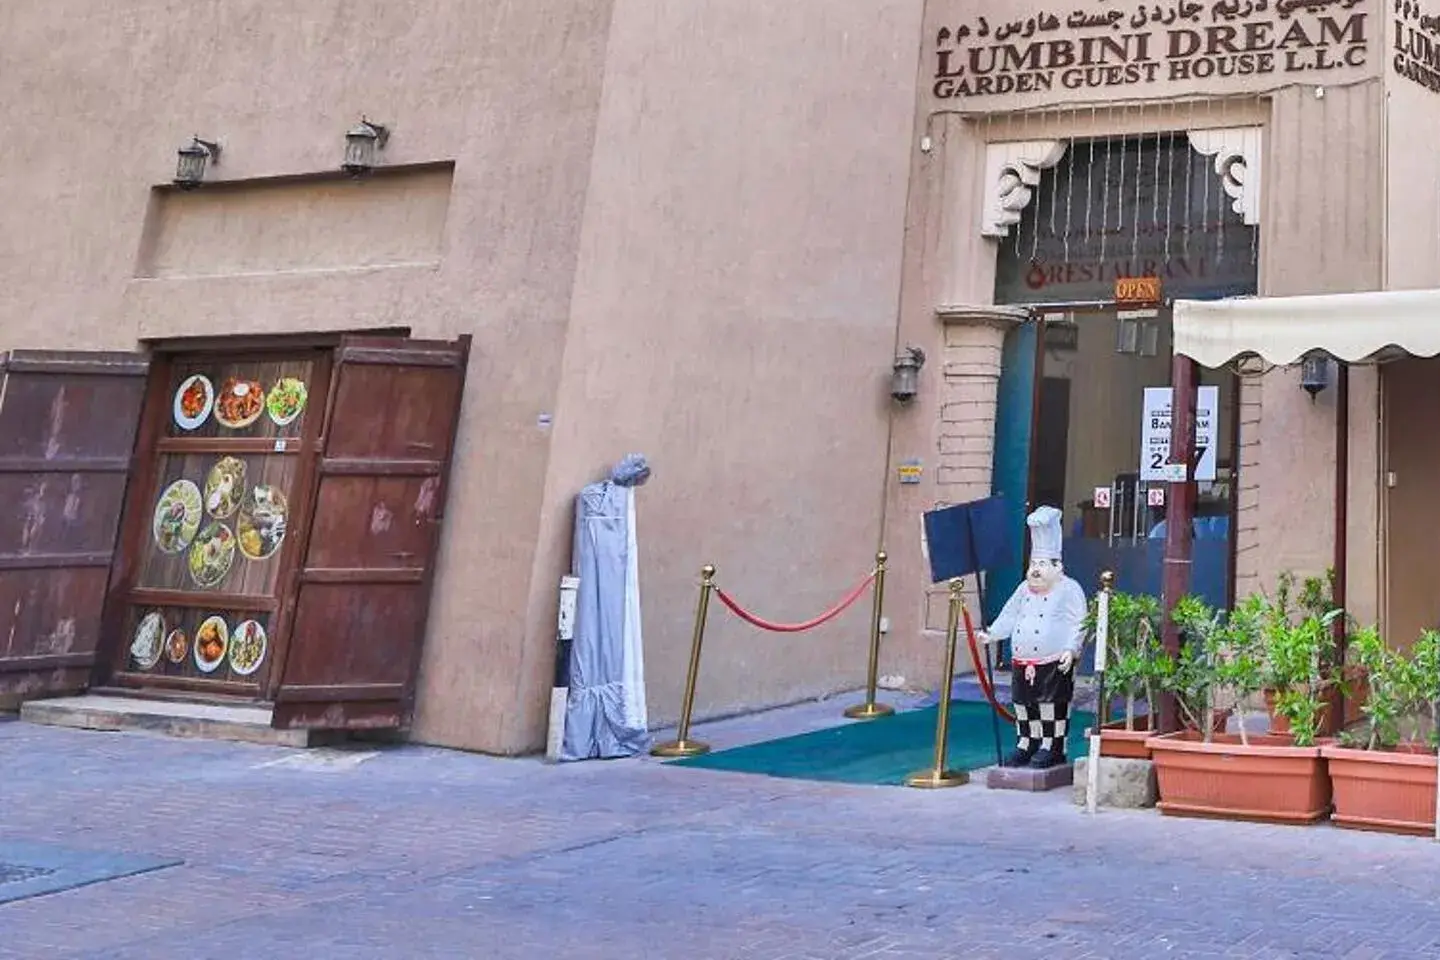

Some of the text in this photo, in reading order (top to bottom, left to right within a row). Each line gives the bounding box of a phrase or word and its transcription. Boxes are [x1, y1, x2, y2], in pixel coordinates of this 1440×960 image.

[995, 11, 1061, 41] هاوس
[1066, 10, 1125, 30] جست
[934, 13, 1368, 80] LUMBINI DREAM
[932, 71, 1055, 100] GARDEN
[1061, 62, 1160, 90] GUEST
[1167, 53, 1276, 81] HOUSE
[1116, 281, 1156, 299] OPEN
